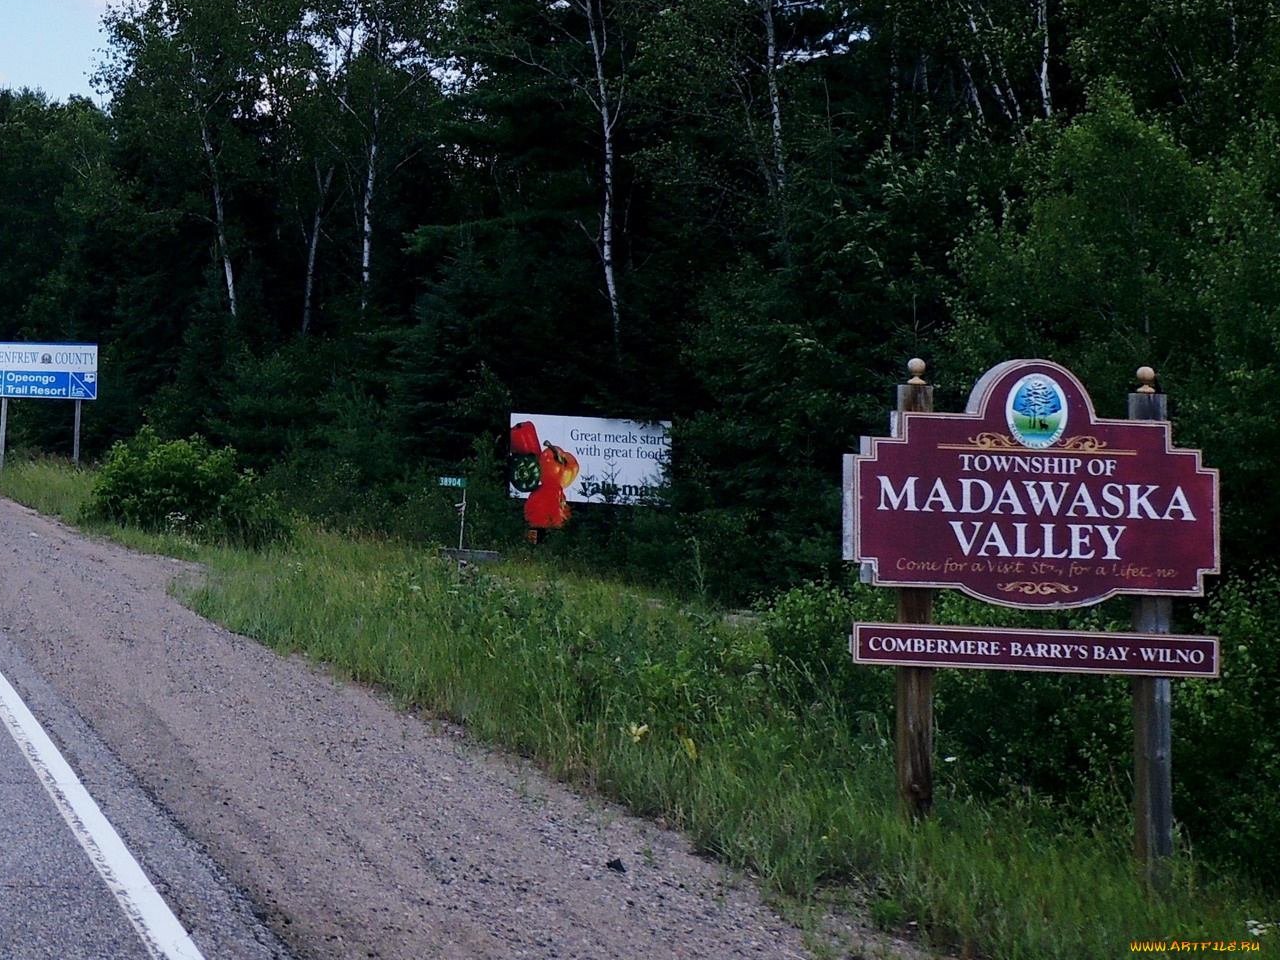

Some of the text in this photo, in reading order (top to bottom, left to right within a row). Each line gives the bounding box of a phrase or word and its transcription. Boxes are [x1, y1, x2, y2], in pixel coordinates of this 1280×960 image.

[55, 352, 95, 365] COUNTY
[6, 372, 56, 385] Opeongo
[6, 385, 67, 396] Trail Resort
[570, 428, 665, 445] Great meals start
[575, 444, 601, 457] with
[603, 447, 634, 461] great
[959, 454, 1117, 476] TOWNSHIP OF
[877, 476, 1197, 521] MADAWASKA
[949, 521, 1127, 560] VALLEY
[896, 557, 940, 571] Come
[943, 558, 967, 573] for
[971, 562, 985, 572] a
[1095, 566, 1108, 576] a
[868, 636, 1001, 656] COMBERMERE
[1093, 645, 1130, 661] BAY
[1139, 646, 1205, 665] WILNO
